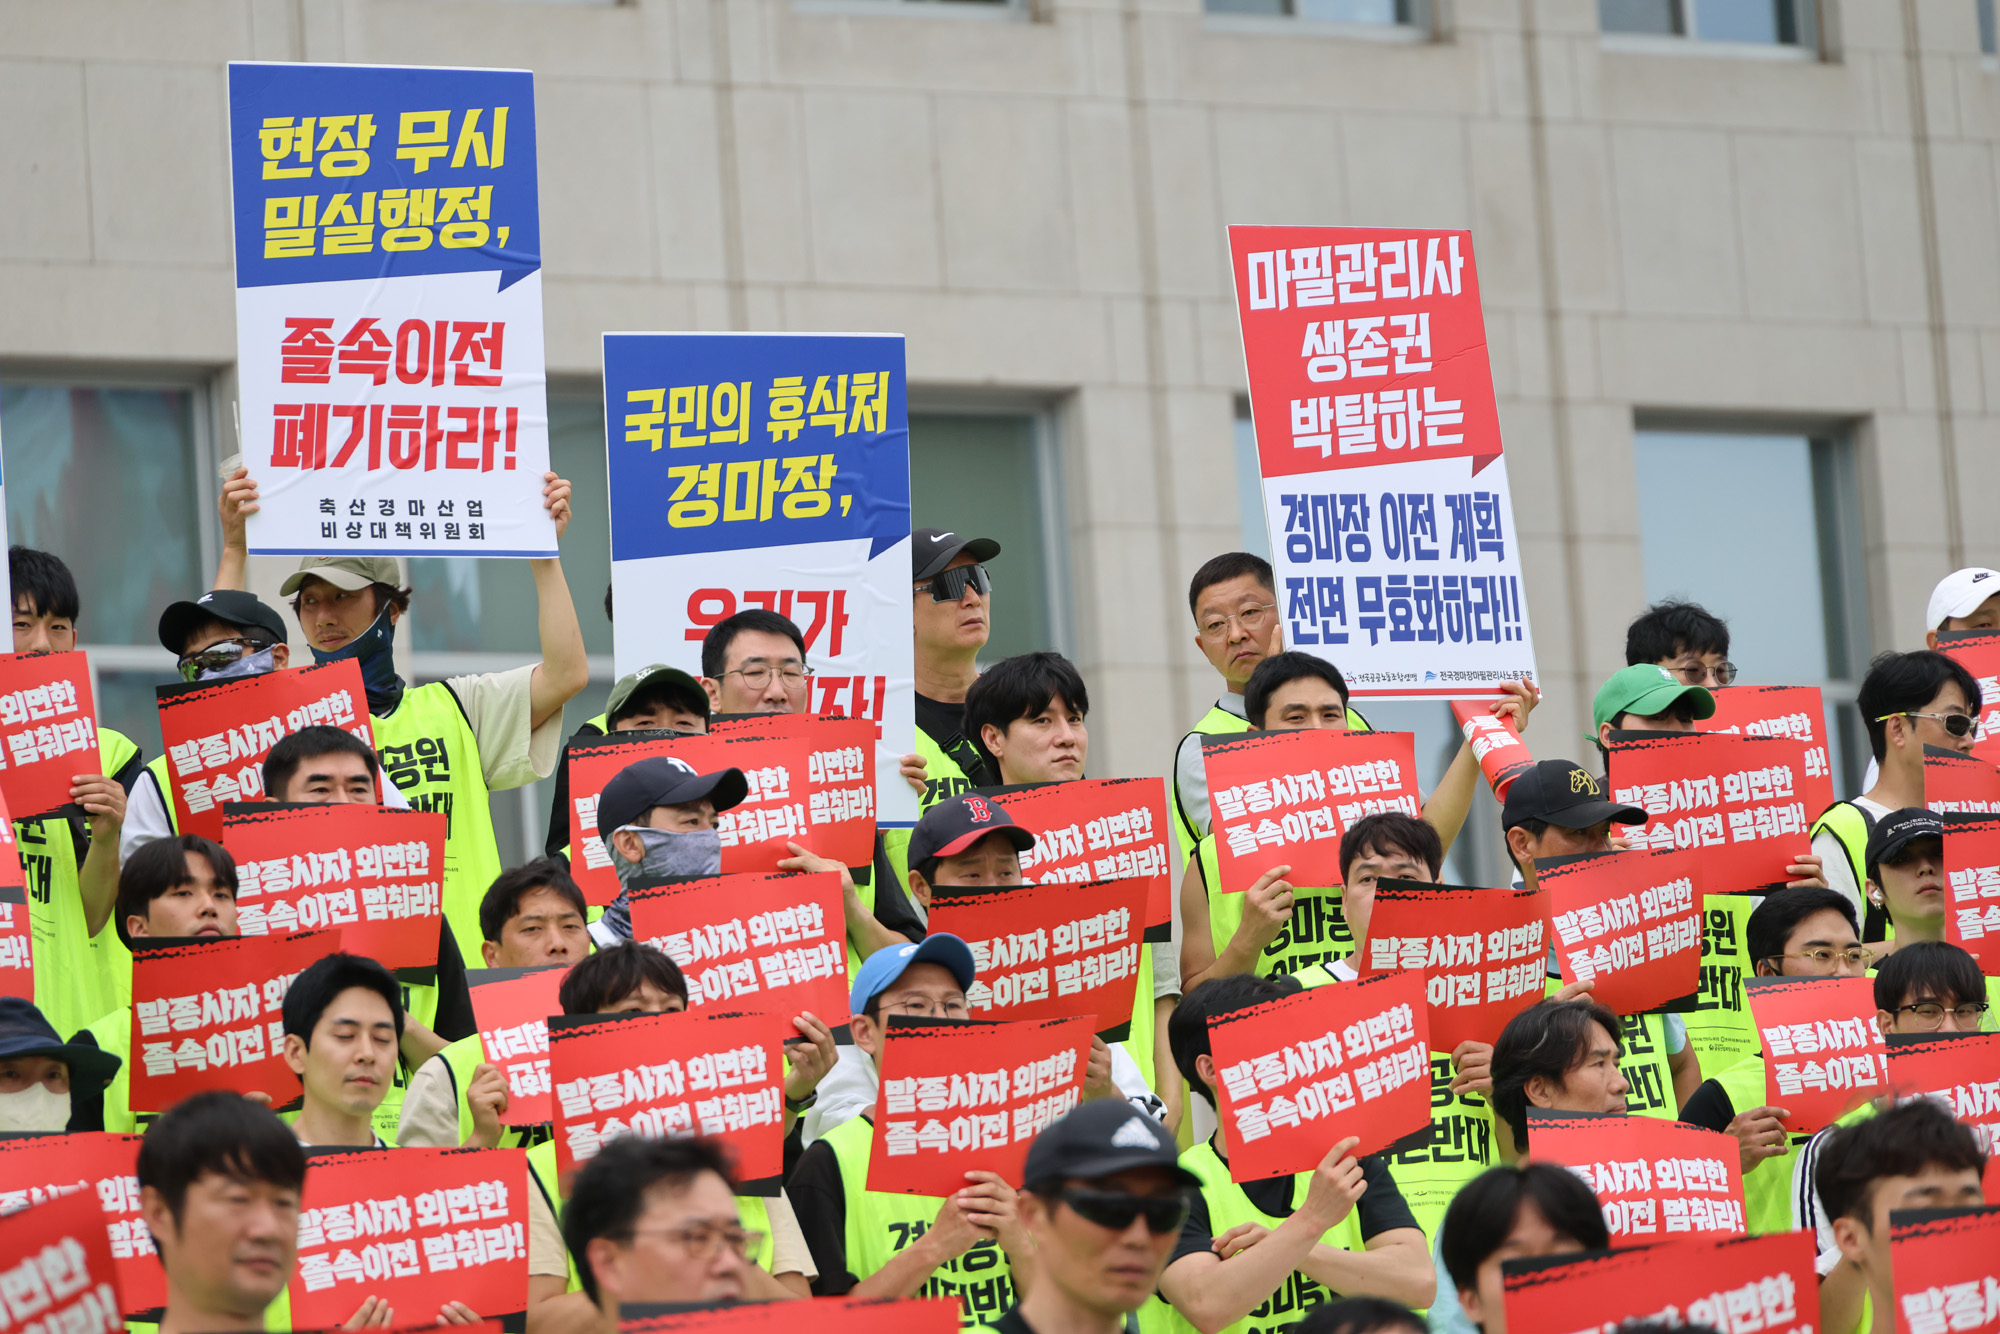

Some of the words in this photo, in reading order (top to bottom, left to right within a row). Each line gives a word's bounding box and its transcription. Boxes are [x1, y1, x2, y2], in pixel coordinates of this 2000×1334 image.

[259, 114, 377, 180] 현장
[396, 107, 509, 174] 무시
[263, 185, 510, 259] 밀실행정,
[1247, 236, 1464, 311] 마필관리사
[281, 317, 506, 387] 졸속이전
[1301, 312, 1433, 383] 생존권
[271, 403, 519, 473] 폐기하라!
[625, 381, 752, 451] 국민의
[767, 371, 890, 442] 휴식처
[1290, 386, 1464, 458] 박탈하는
[667, 454, 852, 529] 경마장,
[1280, 493, 1371, 563] 경마장
[1380, 492, 1439, 563] 이전
[1444, 491, 1504, 563] 계획
[684, 588, 849, 657] 우가
[1286, 576, 1349, 645] 전면
[1356, 574, 1523, 646] 무효화하라!!
[0, 680, 78, 725] 외면한
[7, 716, 97, 766] 멈취라!
[169, 716, 286, 777] 말종사자
[377, 737, 450, 790] 공원
[809, 785, 875, 824] 멈취라!
[1213, 770, 1326, 821] 말종사자
[1329, 760, 1402, 796] 외면한
[1723, 765, 1794, 803] 외면한
[1085, 807, 1154, 849] 외면한
[1225, 806, 1337, 858] 졸속이전
[1728, 802, 1807, 847] 멈취라!
[235, 848, 352, 898] 말종사자
[355, 841, 430, 880] 외면한
[237, 888, 359, 935] 졸속이전
[361, 881, 440, 922] 멈취라!
[641, 918, 748, 968] 종사자
[748, 902, 825, 948] 외면한
[1052, 907, 1131, 956] 외면한
[1552, 893, 1642, 947] 말종사자
[1641, 876, 1693, 919] 외면한
[758, 940, 844, 989] 멈취라!
[1055, 943, 1137, 994] 멈취라!
[1370, 931, 1483, 971] 말종사자
[1487, 919, 1544, 970] 외면한
[1566, 932, 1645, 982] 졸속이전
[1647, 914, 1701, 961] 멈취라!
[137, 983, 263, 1036] 말종사자
[1486, 957, 1545, 1005] 멈취라!
[142, 1022, 266, 1077] 졸속이전
[1219, 1031, 1342, 1102] 말종사자
[1342, 1002, 1415, 1058] 외면한
[1762, 1016, 1867, 1057] 말종사자
[556, 1058, 684, 1119] 말종사자
[687, 1044, 767, 1091] 외면한
[884, 1068, 1010, 1114] 말종사자
[1012, 1048, 1078, 1096] 외면한
[1233, 1071, 1356, 1144] 졸속이전
[1355, 1041, 1429, 1102] 멈취라!
[1775, 1053, 1878, 1096] 졸속이전
[696, 1086, 782, 1136] 멈취라!
[886, 1111, 1009, 1157] 졸속이전
[1654, 1156, 1729, 1194] 외면한
[297, 1194, 412, 1249] 말종사자
[415, 1180, 509, 1228] 외면한
[1662, 1197, 1745, 1236] 멈취라!
[299, 1239, 421, 1293] 졸속이전
[423, 1222, 526, 1274] 멈취라!
